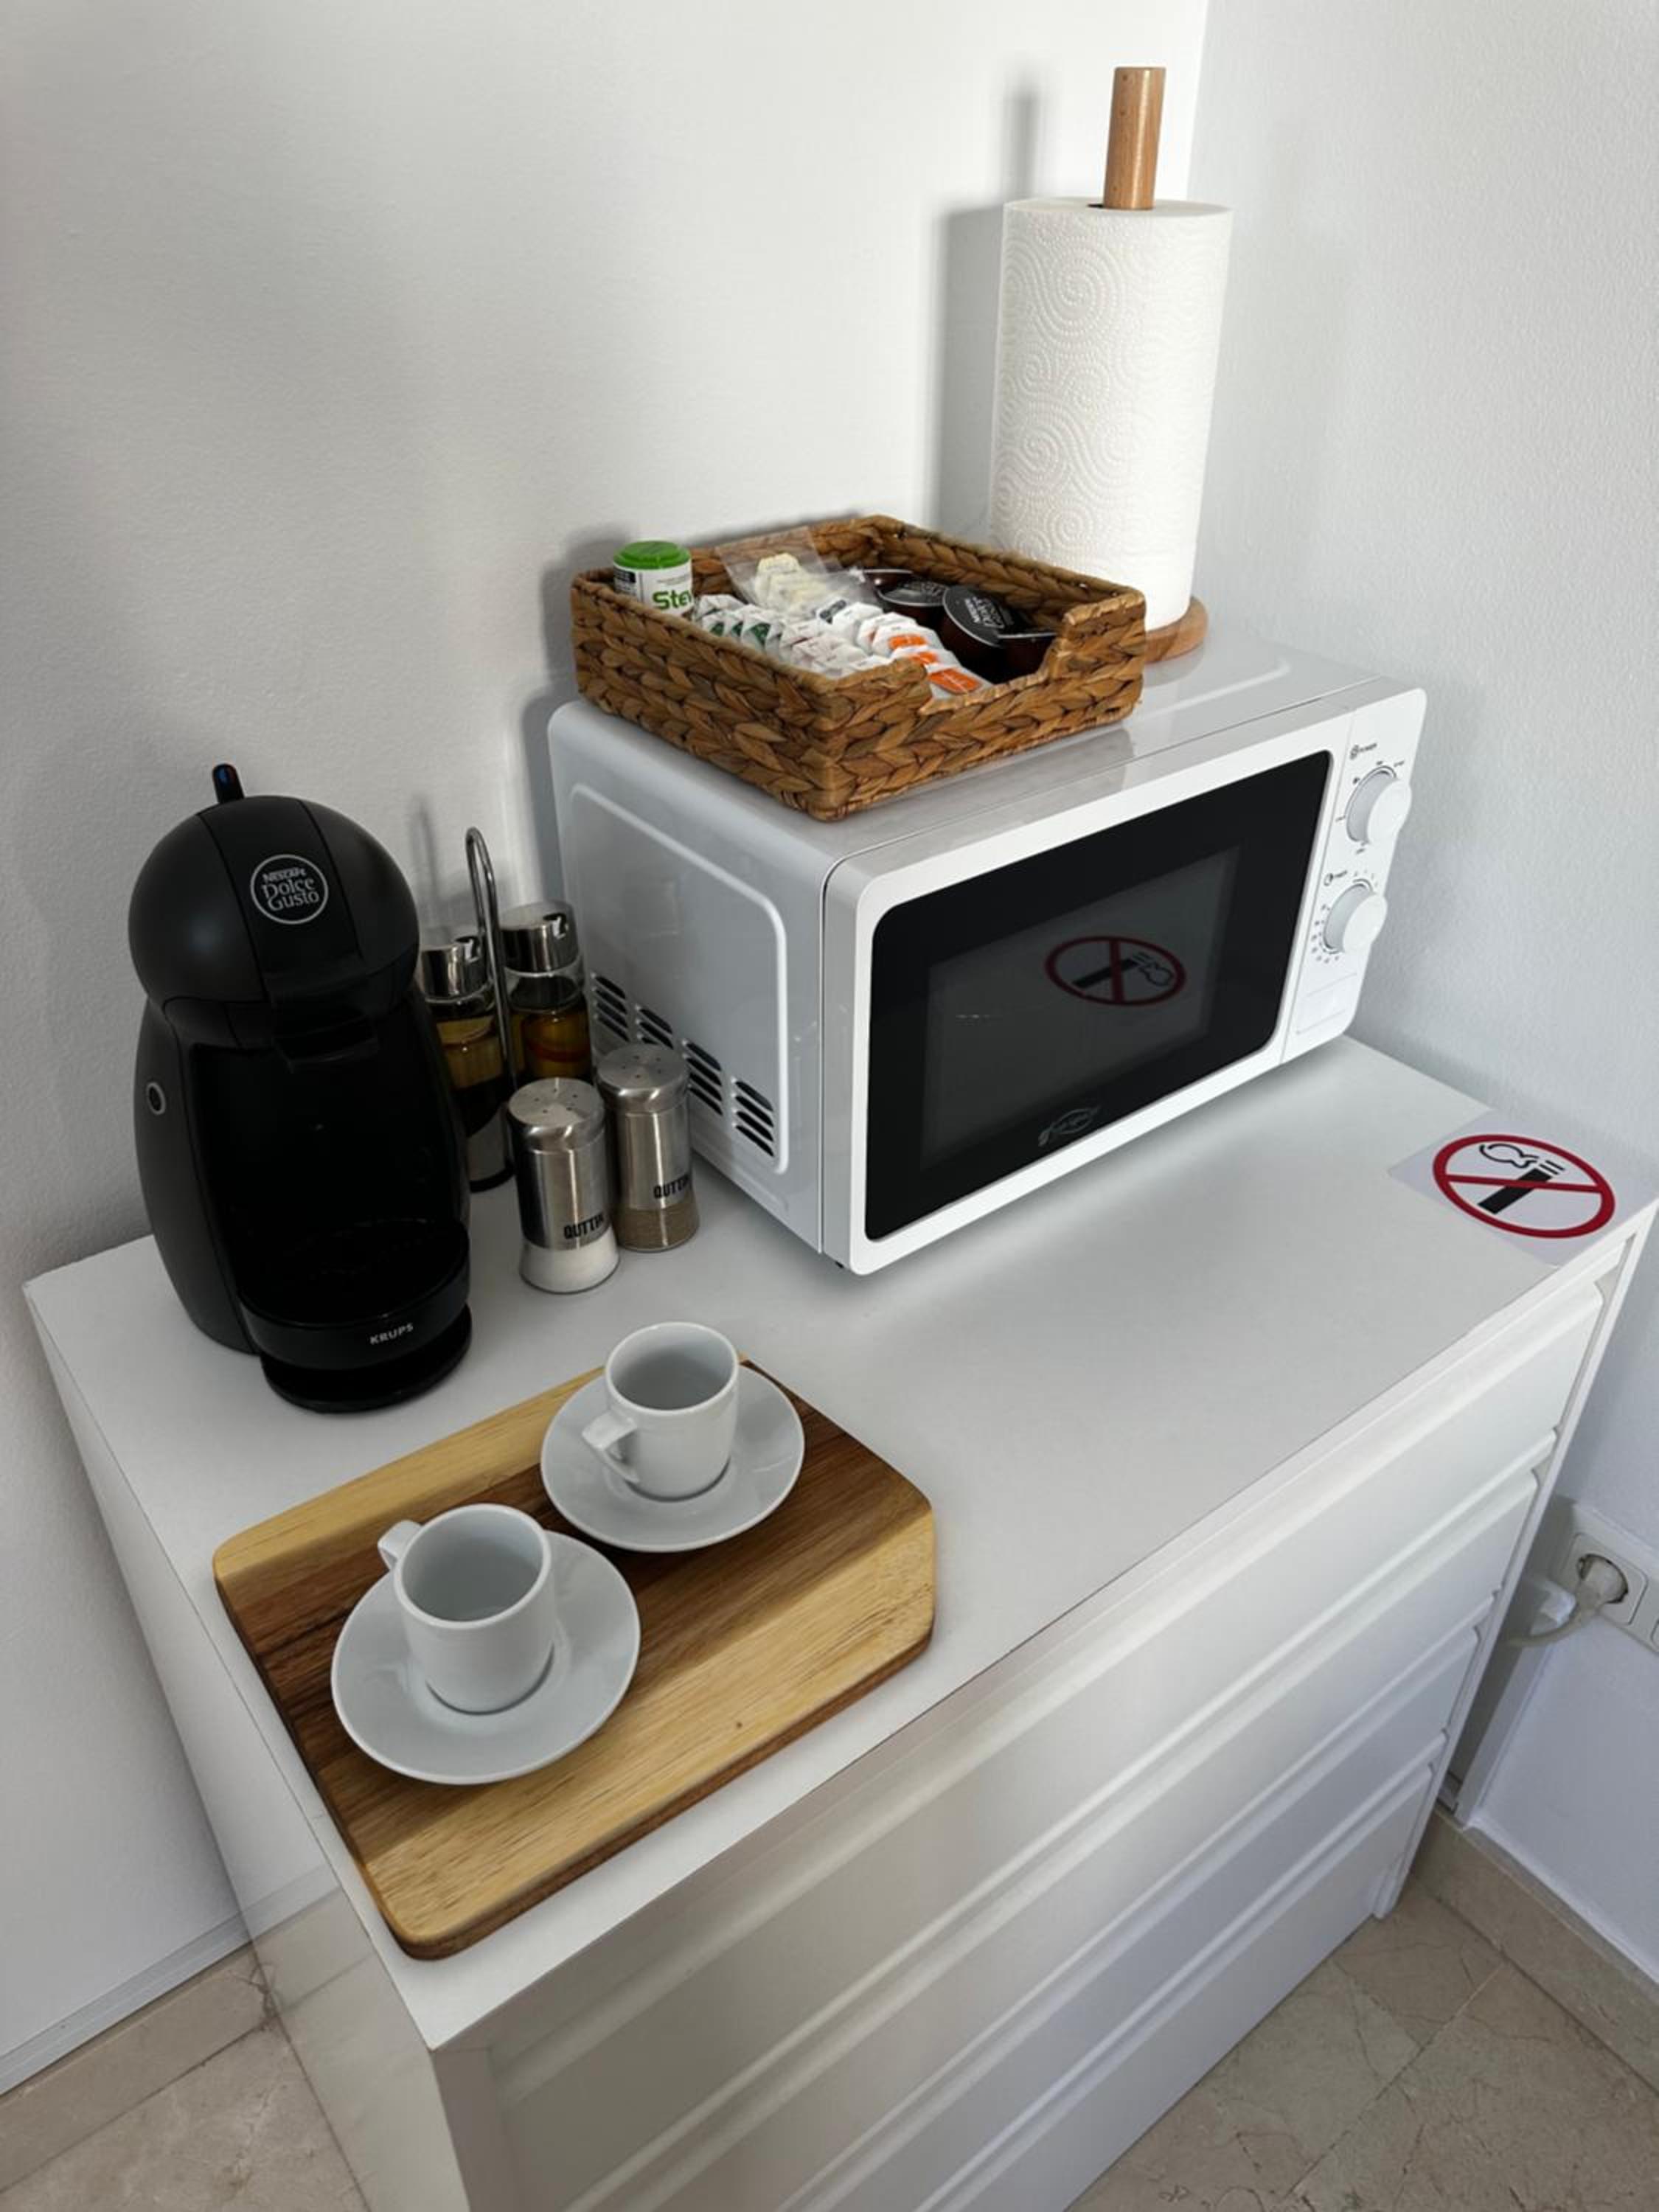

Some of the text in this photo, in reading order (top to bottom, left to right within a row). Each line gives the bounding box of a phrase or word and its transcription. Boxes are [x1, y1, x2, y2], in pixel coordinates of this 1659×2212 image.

[262, 878, 315, 900] Dolce
[268, 891, 319, 911] Gusto
[370, 1323, 414, 1345] KRUPS
